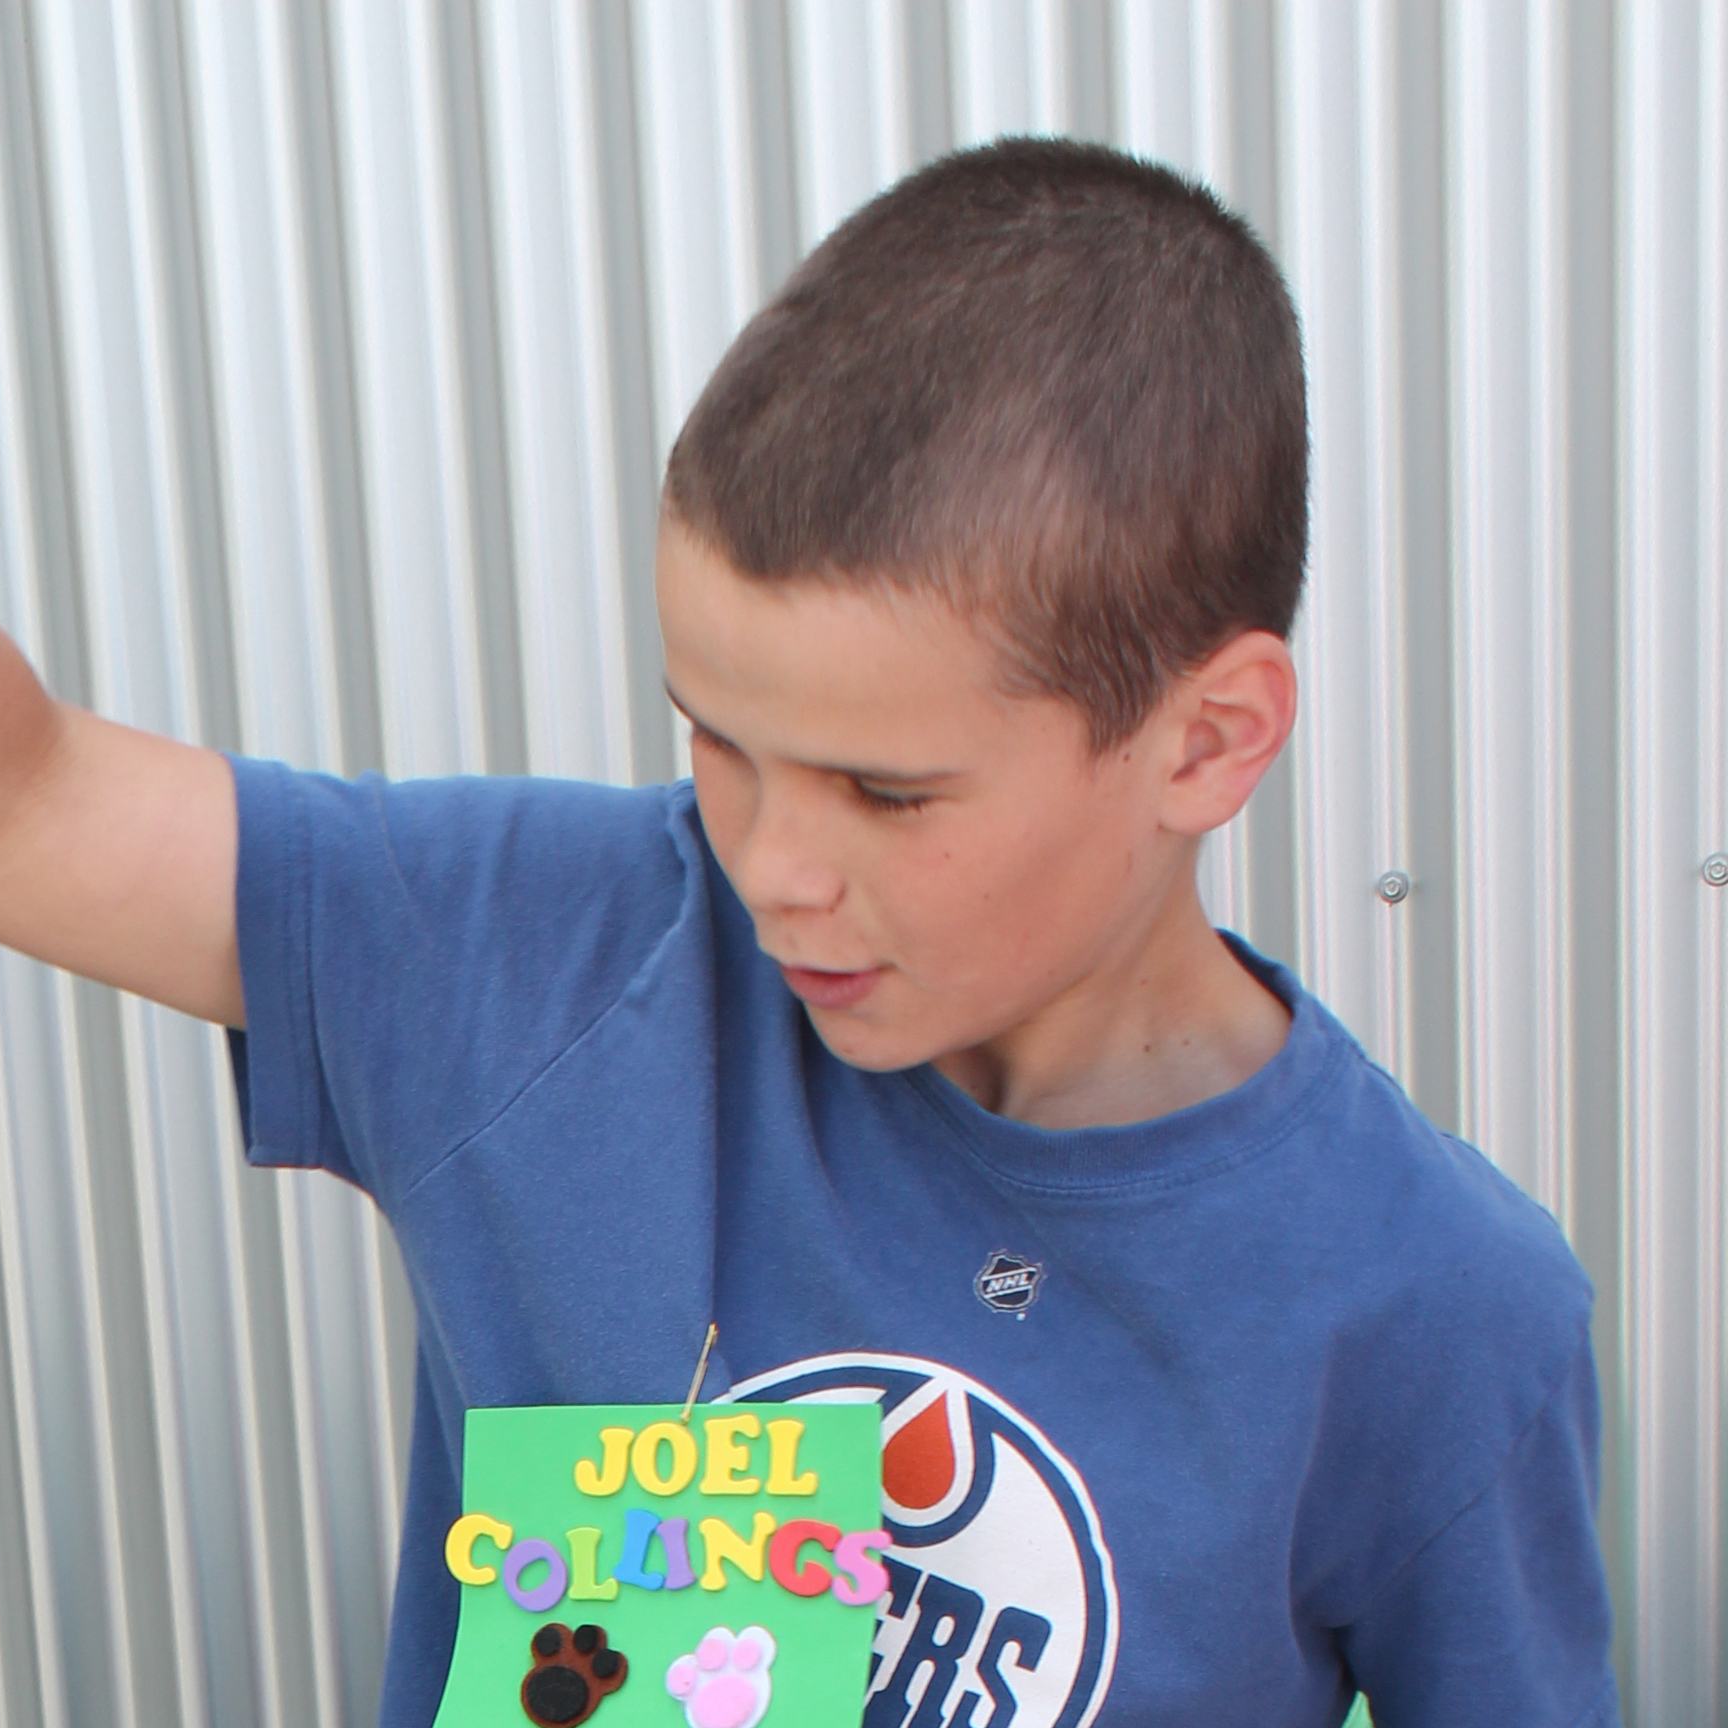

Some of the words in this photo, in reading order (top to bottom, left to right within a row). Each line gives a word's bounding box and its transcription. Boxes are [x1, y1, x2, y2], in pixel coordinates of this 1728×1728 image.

[985, 1271, 1031, 1293] NHL
[575, 1414, 818, 1496] JOEL
[444, 1509, 893, 1613] COLLINGS
